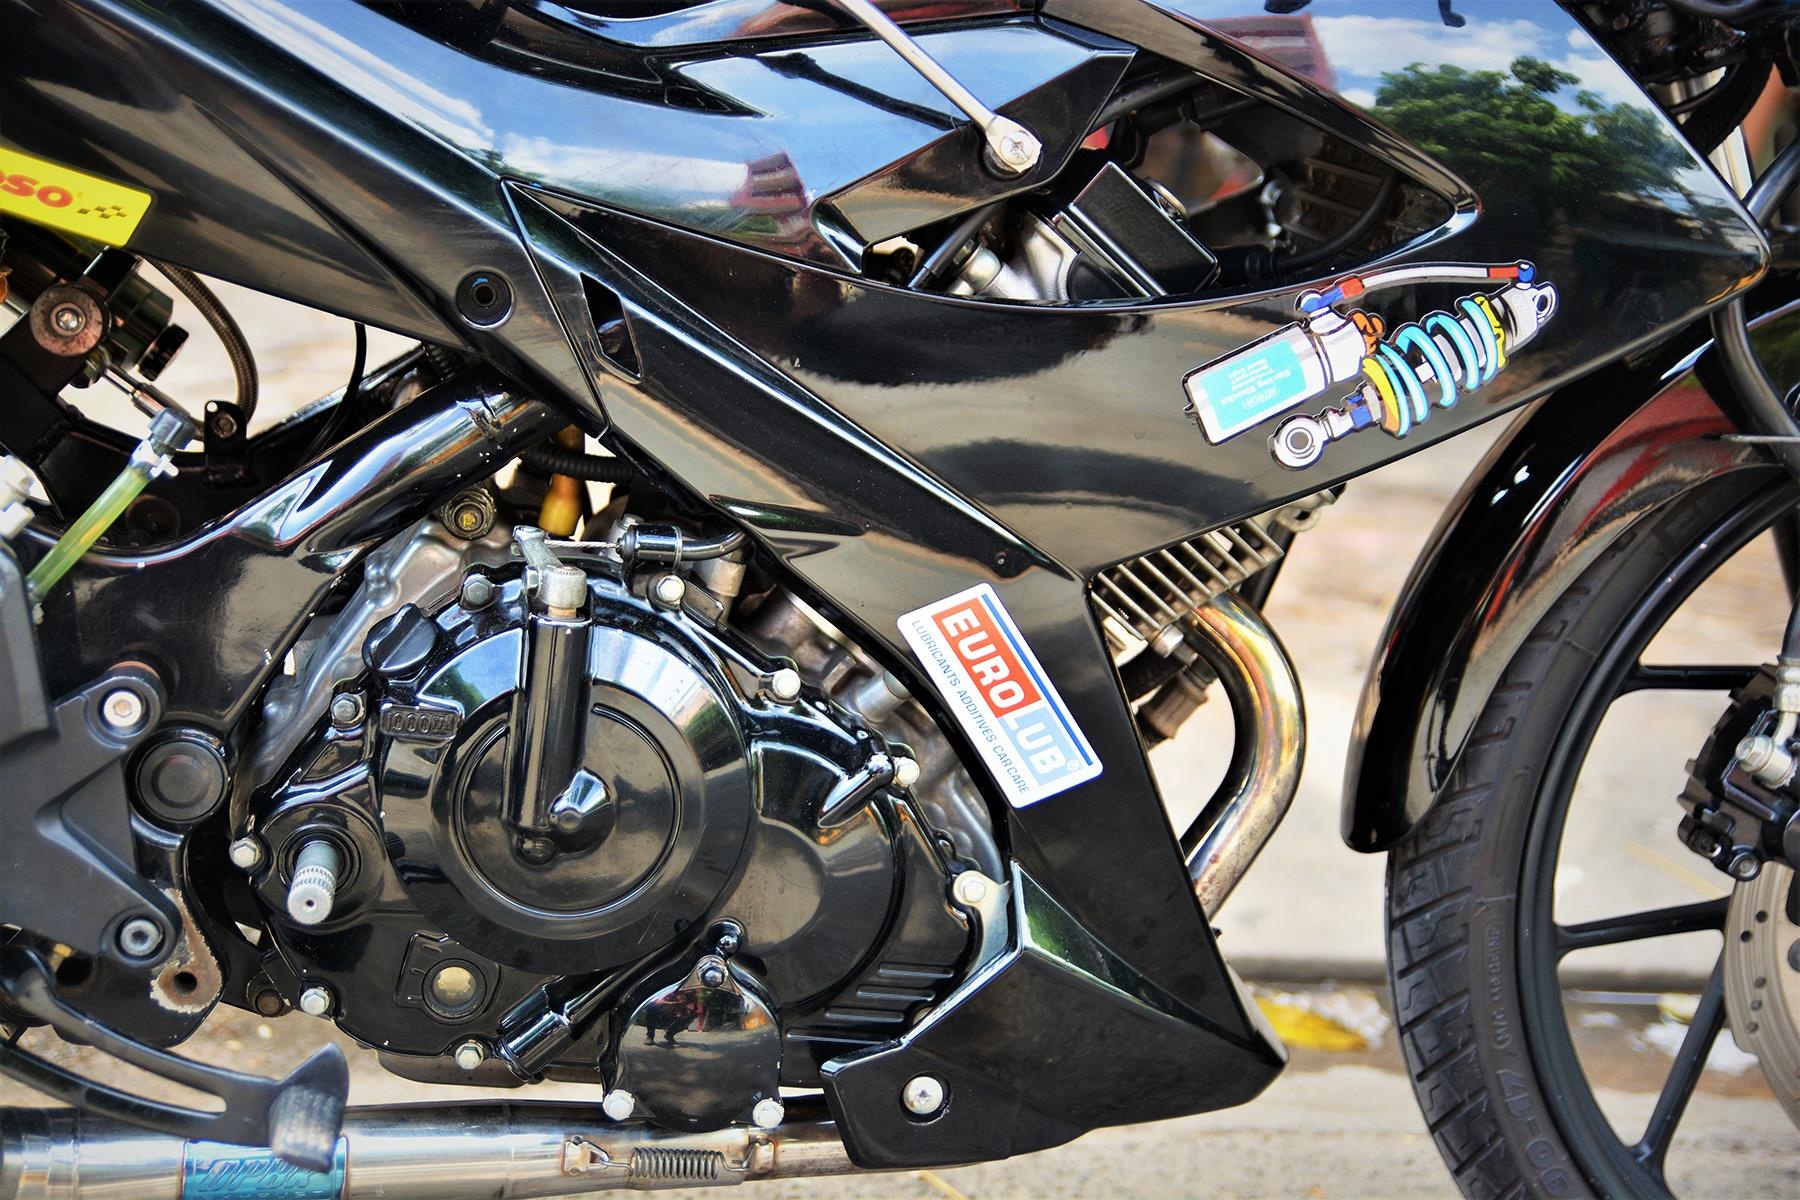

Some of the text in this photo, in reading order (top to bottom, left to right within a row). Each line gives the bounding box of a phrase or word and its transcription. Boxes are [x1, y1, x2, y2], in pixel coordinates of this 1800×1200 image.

[0, 171, 72, 207] SO
[911, 620, 961, 687] LUBRICANTS
[957, 690, 996, 743] ADDITIVES
